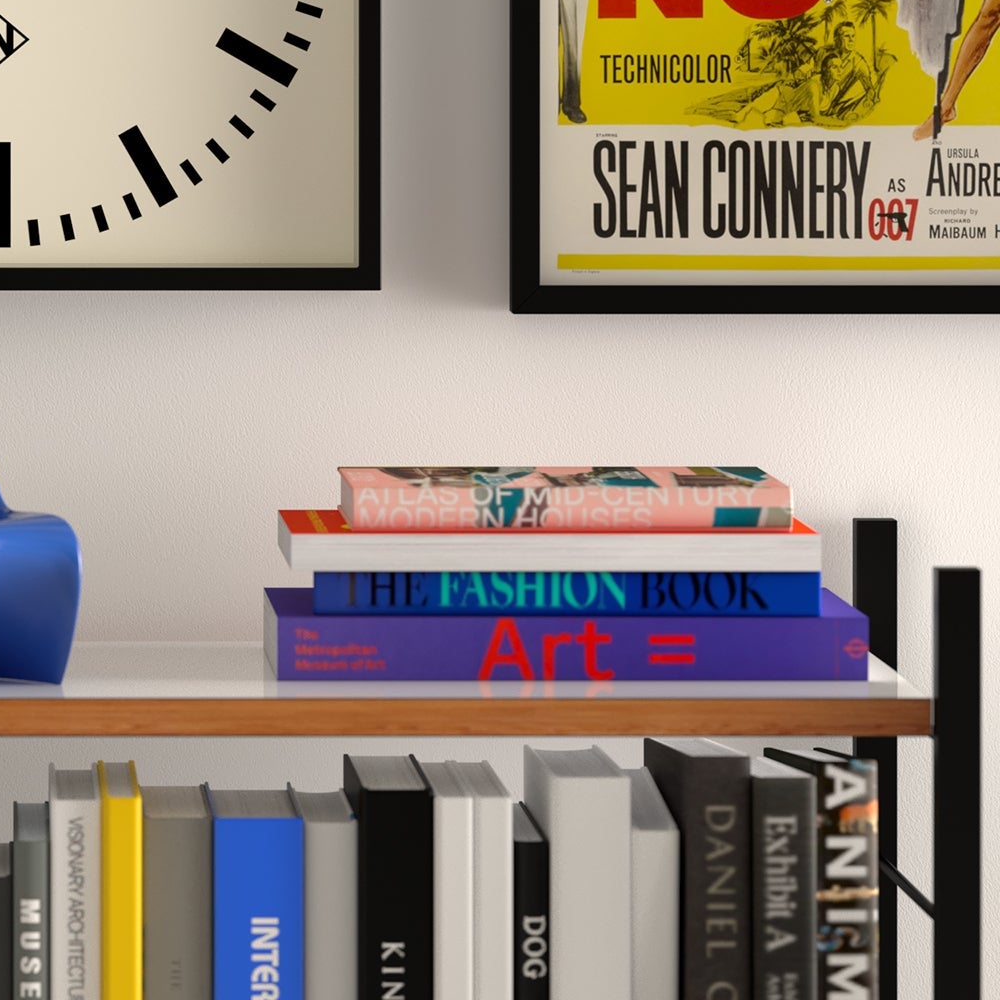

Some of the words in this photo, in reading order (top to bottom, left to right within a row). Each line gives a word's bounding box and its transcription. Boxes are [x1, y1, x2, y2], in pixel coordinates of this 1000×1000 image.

[599, 54, 732, 84] TECHNICOLOR
[946, 147, 980, 159] URSULA
[593, 139, 689, 240] SEAN
[702, 139, 871, 240] CONNERY
[887, 178, 906, 193] AS
[868, 198, 920, 241] 007
[928, 208, 968, 217] Screenplay
[969, 208, 979, 217] by
[929, 224, 987, 239] MAIBAUM
[358, 487, 459, 506] ATLAS
[470, 486, 514, 506] OF
[523, 486, 757, 506] MID-CENTURY
[358, 507, 507, 528] MODERN
[518, 507, 653, 528] HOUSES
[345, 571, 429, 610] THE
[437, 571, 627, 611] FASHION
[639, 571, 770, 611] BOOK
[477, 617, 616, 681] Art
[68, 816, 86, 895] VISIONARY
[764, 816, 798, 919] Exhibit
[703, 804, 738, 958] DANIEL
[19, 898, 42, 999] MUSE
[250, 916, 281, 1000] INTER
[522, 915, 548, 980] DOG
[764, 926, 798, 952] A
